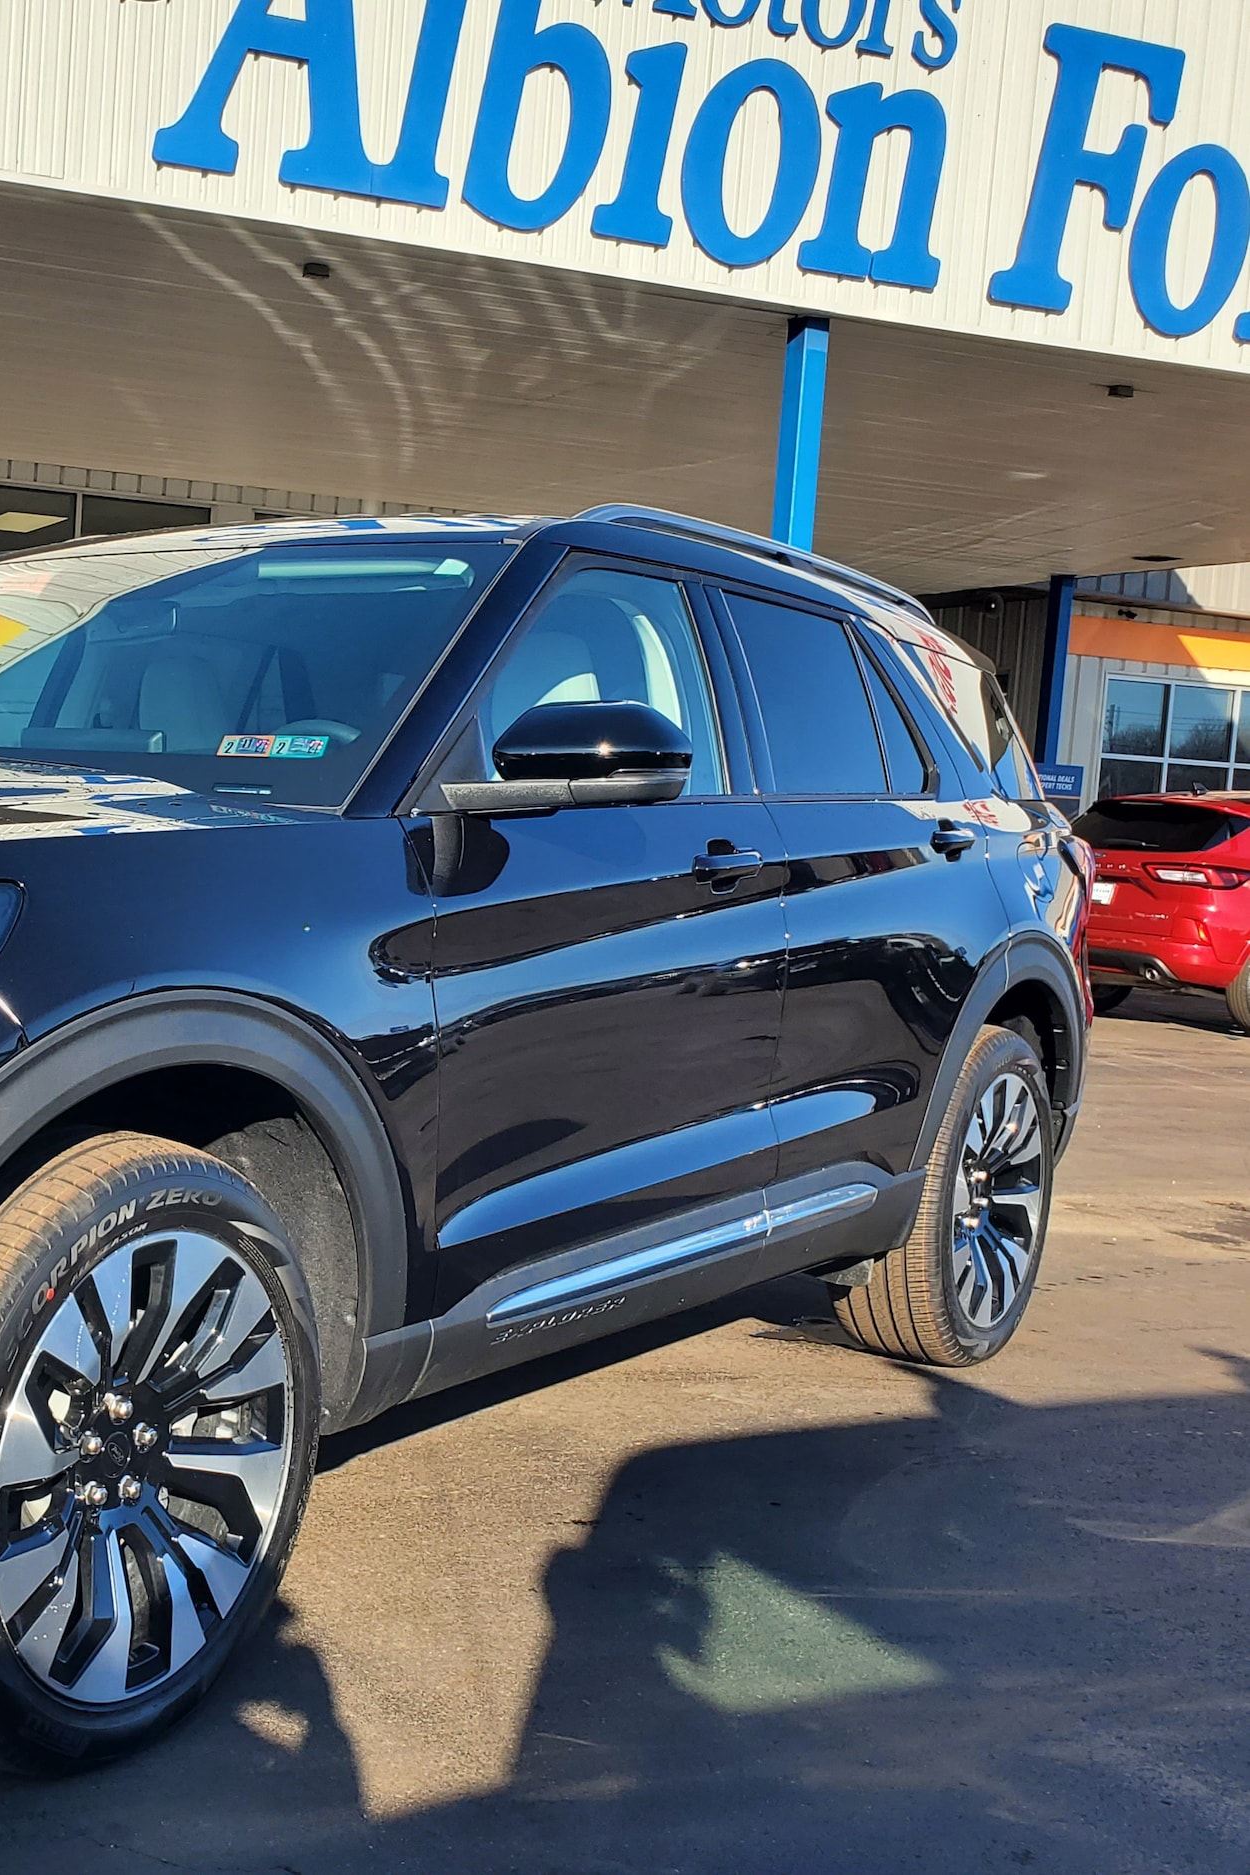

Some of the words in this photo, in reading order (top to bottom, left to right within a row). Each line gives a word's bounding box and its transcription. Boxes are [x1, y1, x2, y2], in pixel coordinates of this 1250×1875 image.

[153, 0, 947, 291] Albion
[988, 24, 1250, 343] Fo
[1056, 783, 1073, 791] TECHS
[1057, 775, 1075, 783] DEALS
[145, 1186, 224, 1212] ZERO
